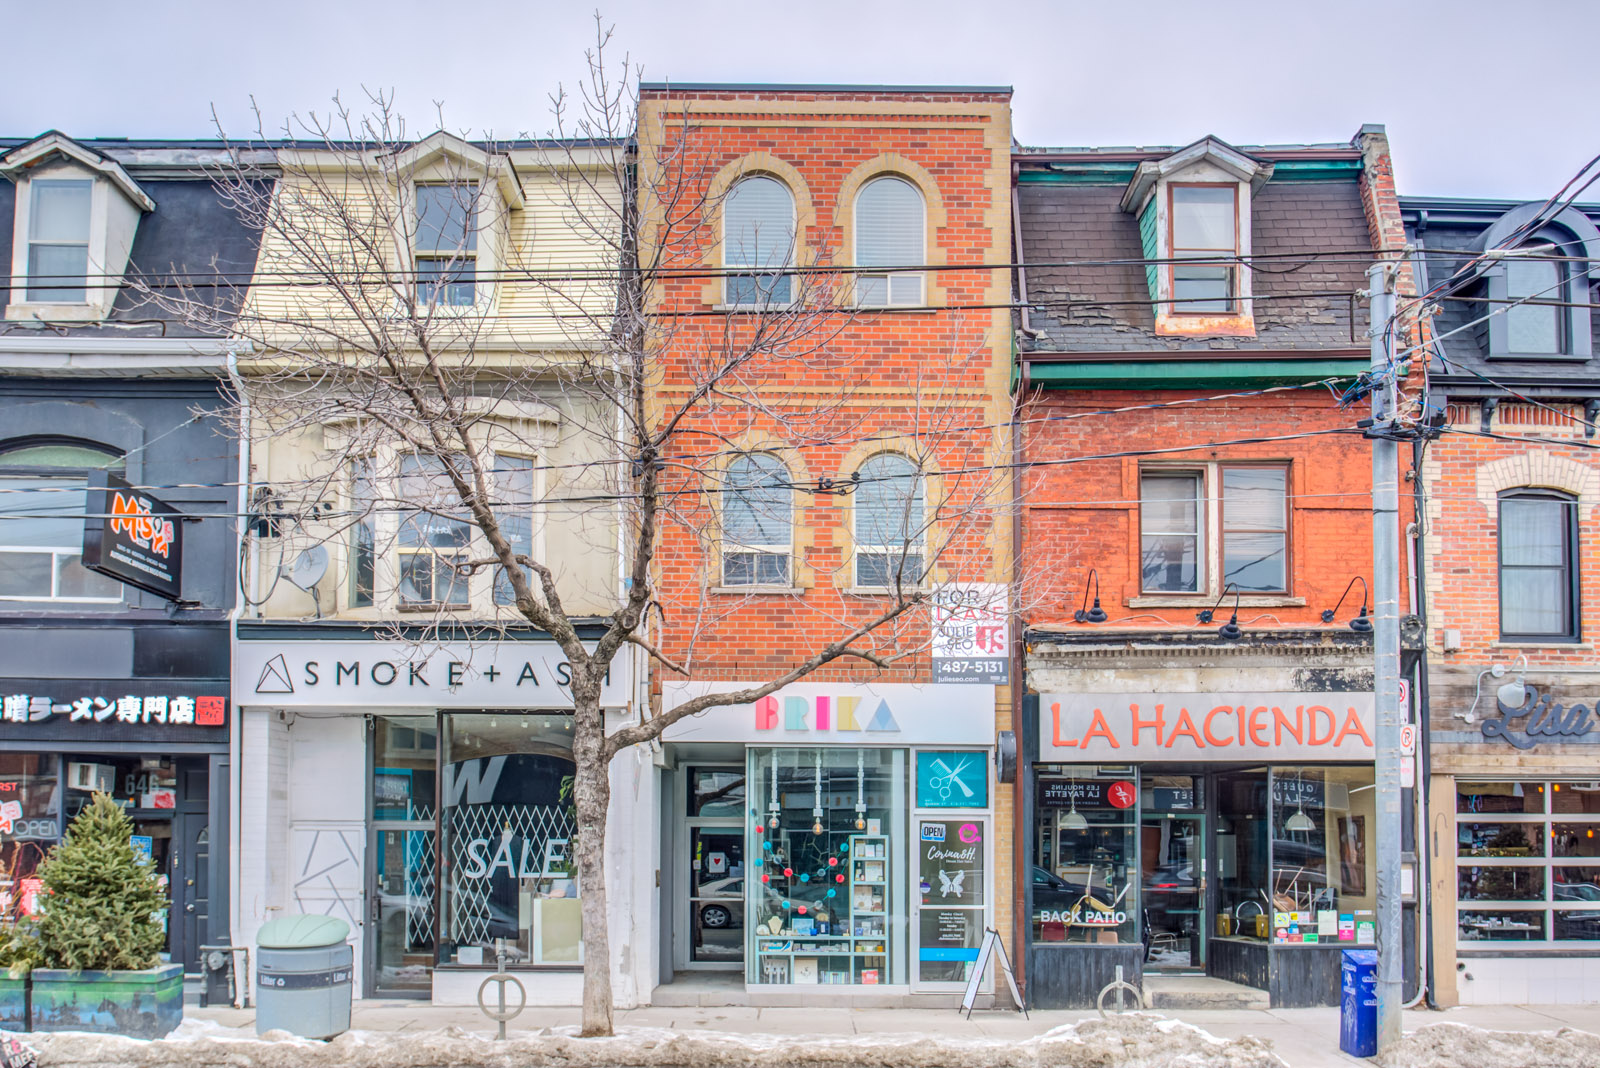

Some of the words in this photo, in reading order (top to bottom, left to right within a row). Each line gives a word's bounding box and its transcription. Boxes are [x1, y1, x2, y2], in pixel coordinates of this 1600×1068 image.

[938, 590, 980, 604] FOR
[937, 606, 1004, 621] LEASE
[938, 626, 973, 638] JULIE
[947, 639, 973, 650] SEO
[755, 696, 901, 732] BRIKA
[1481, 685, 1595, 750] Lisa
[1051, 702, 1120, 749] LA
[1129, 702, 1374, 749] HACIENDA
[125, 774, 160, 795] 646
[923, 826, 944, 837] OPEN
[465, 838, 569, 879] SALE
[1040, 910, 1082, 923] BACK
[1085, 911, 1127, 924] PATIO
